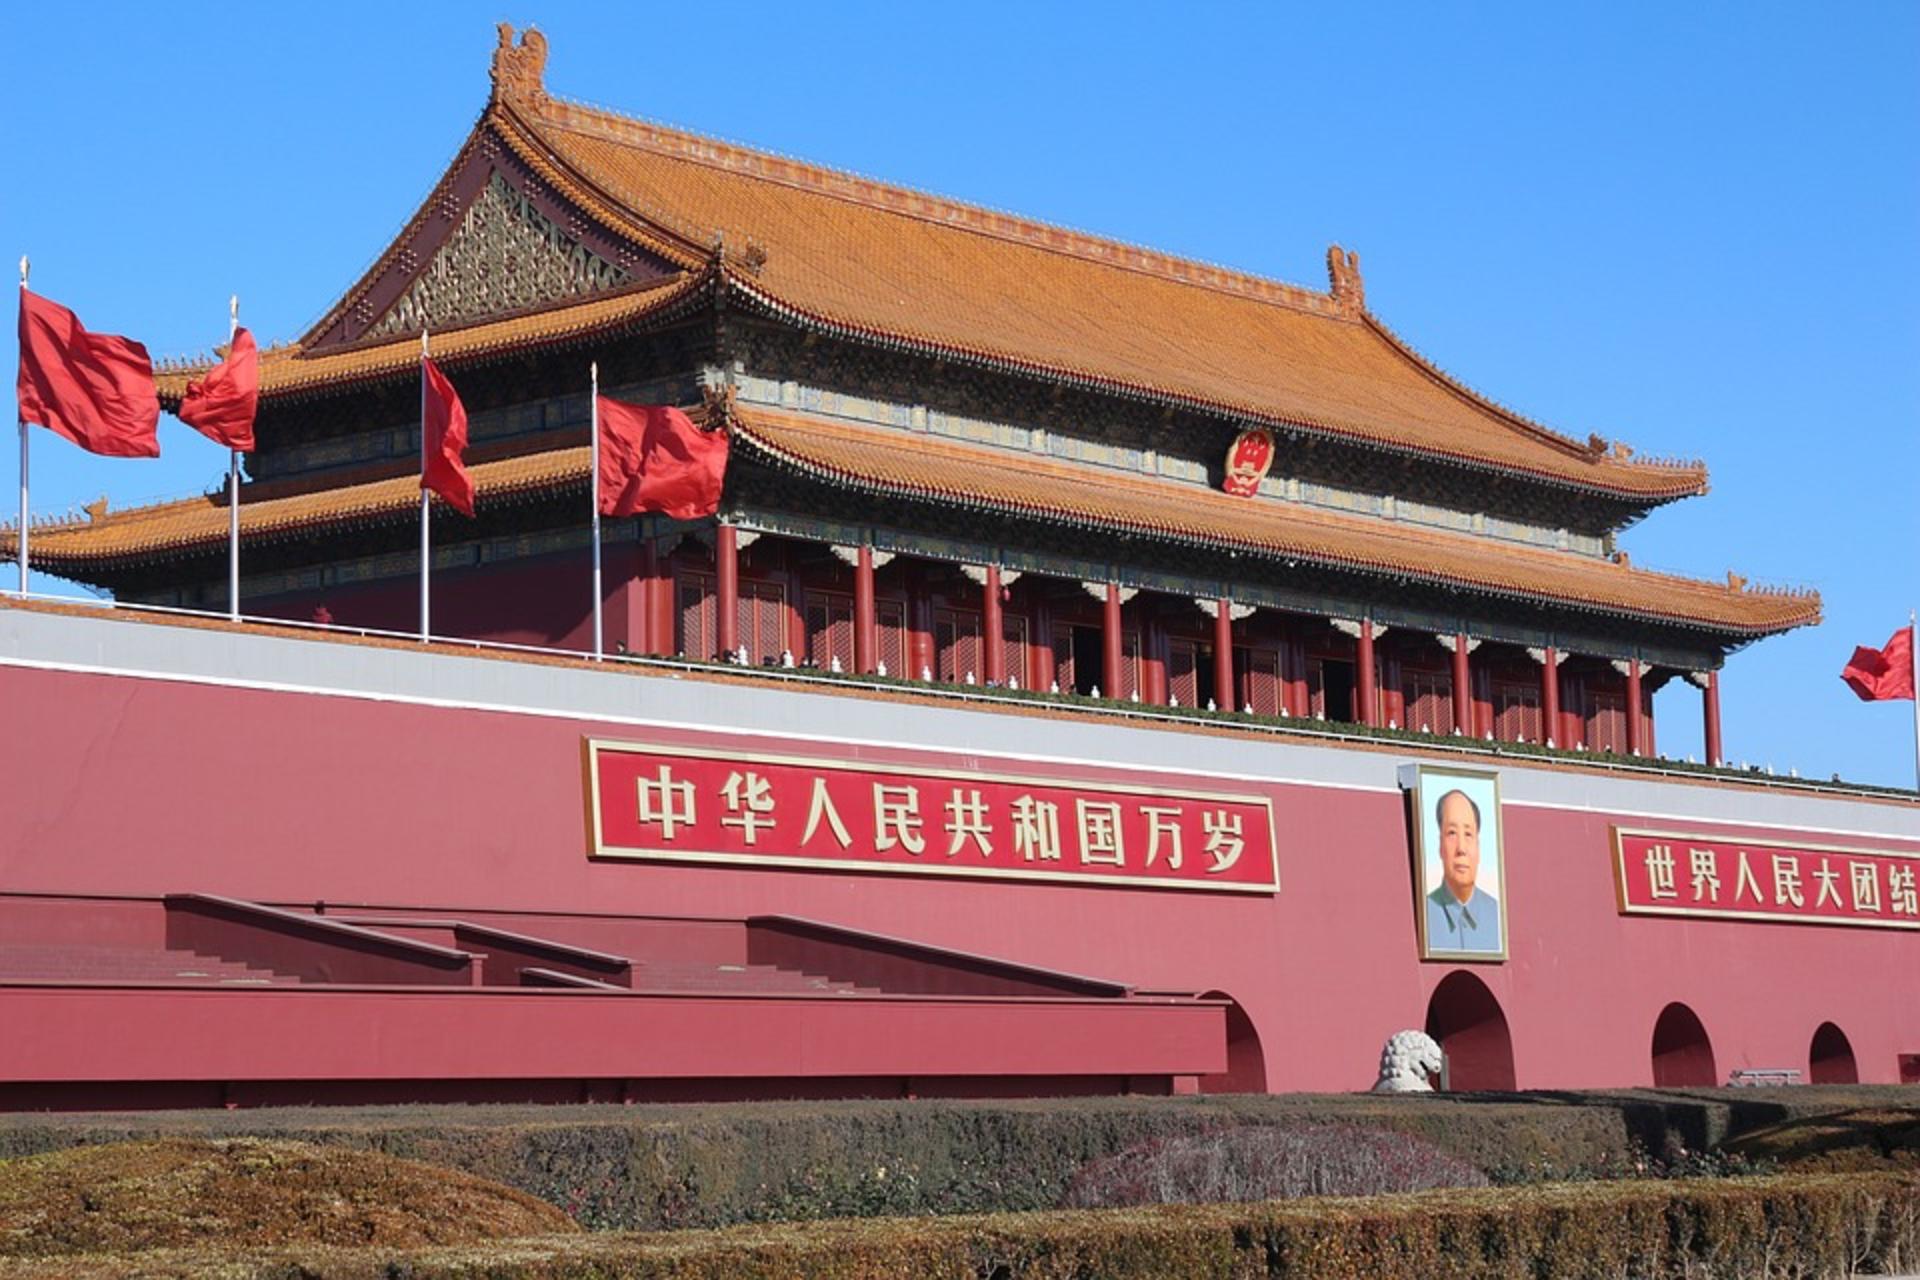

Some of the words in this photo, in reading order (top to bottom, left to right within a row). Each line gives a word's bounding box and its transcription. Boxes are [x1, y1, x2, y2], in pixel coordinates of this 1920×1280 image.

[637, 765, 1246, 872] 中华人民共和国万岁
[1645, 845, 1918, 914] 世界人民大团结
